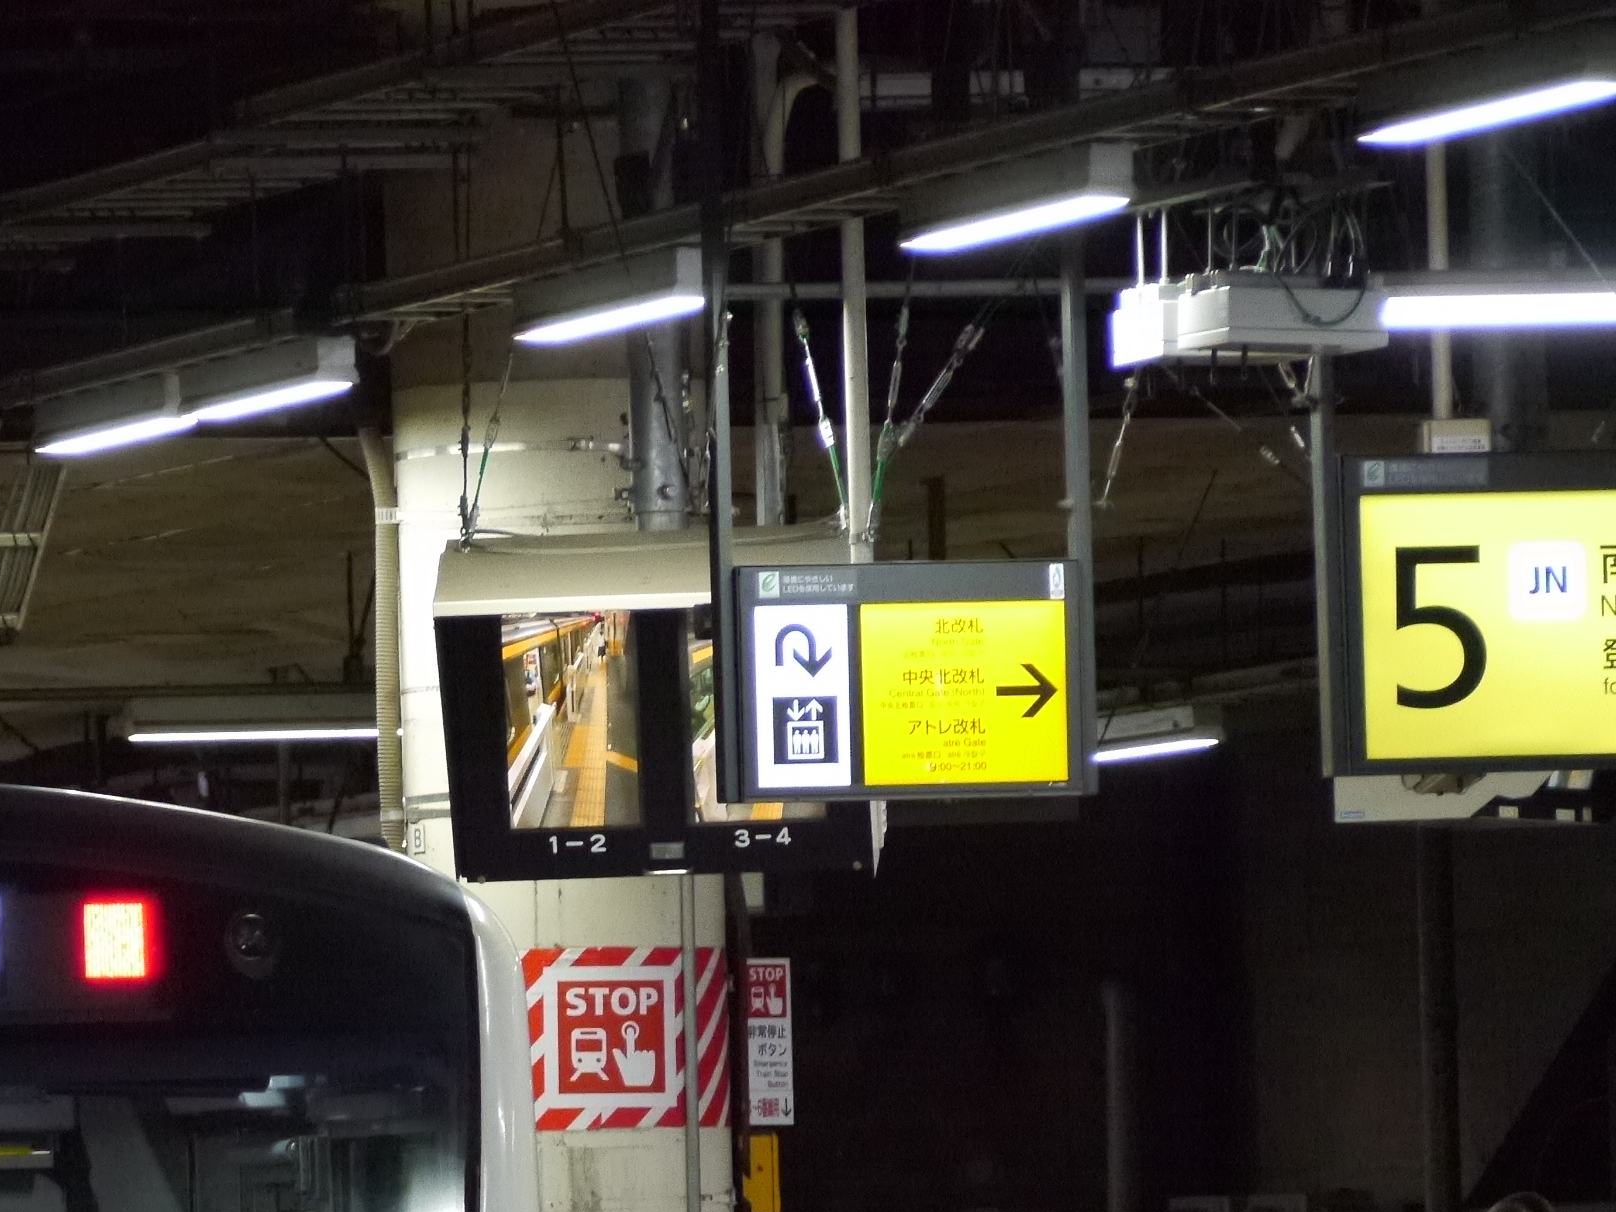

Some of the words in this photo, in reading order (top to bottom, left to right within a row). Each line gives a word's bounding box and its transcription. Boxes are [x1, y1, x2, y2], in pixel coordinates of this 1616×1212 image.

[934, 617, 984, 635] 北改札
[1395, 545, 1488, 709] 5
[1528, 566, 1568, 595] JN
[902, 667, 985, 686] 中央北改札
[888, 689, 924, 699] Central
[926, 688, 950, 698] Gate
[908, 717, 986, 735] アトレ改札
[963, 737, 987, 748] Gate
[549, 833, 607, 854] 1-2
[734, 827, 792, 848] 3-4
[748, 966, 784, 981] STOP
[565, 986, 659, 1017] STOP
[757, 1042, 787, 1057] ボタン
